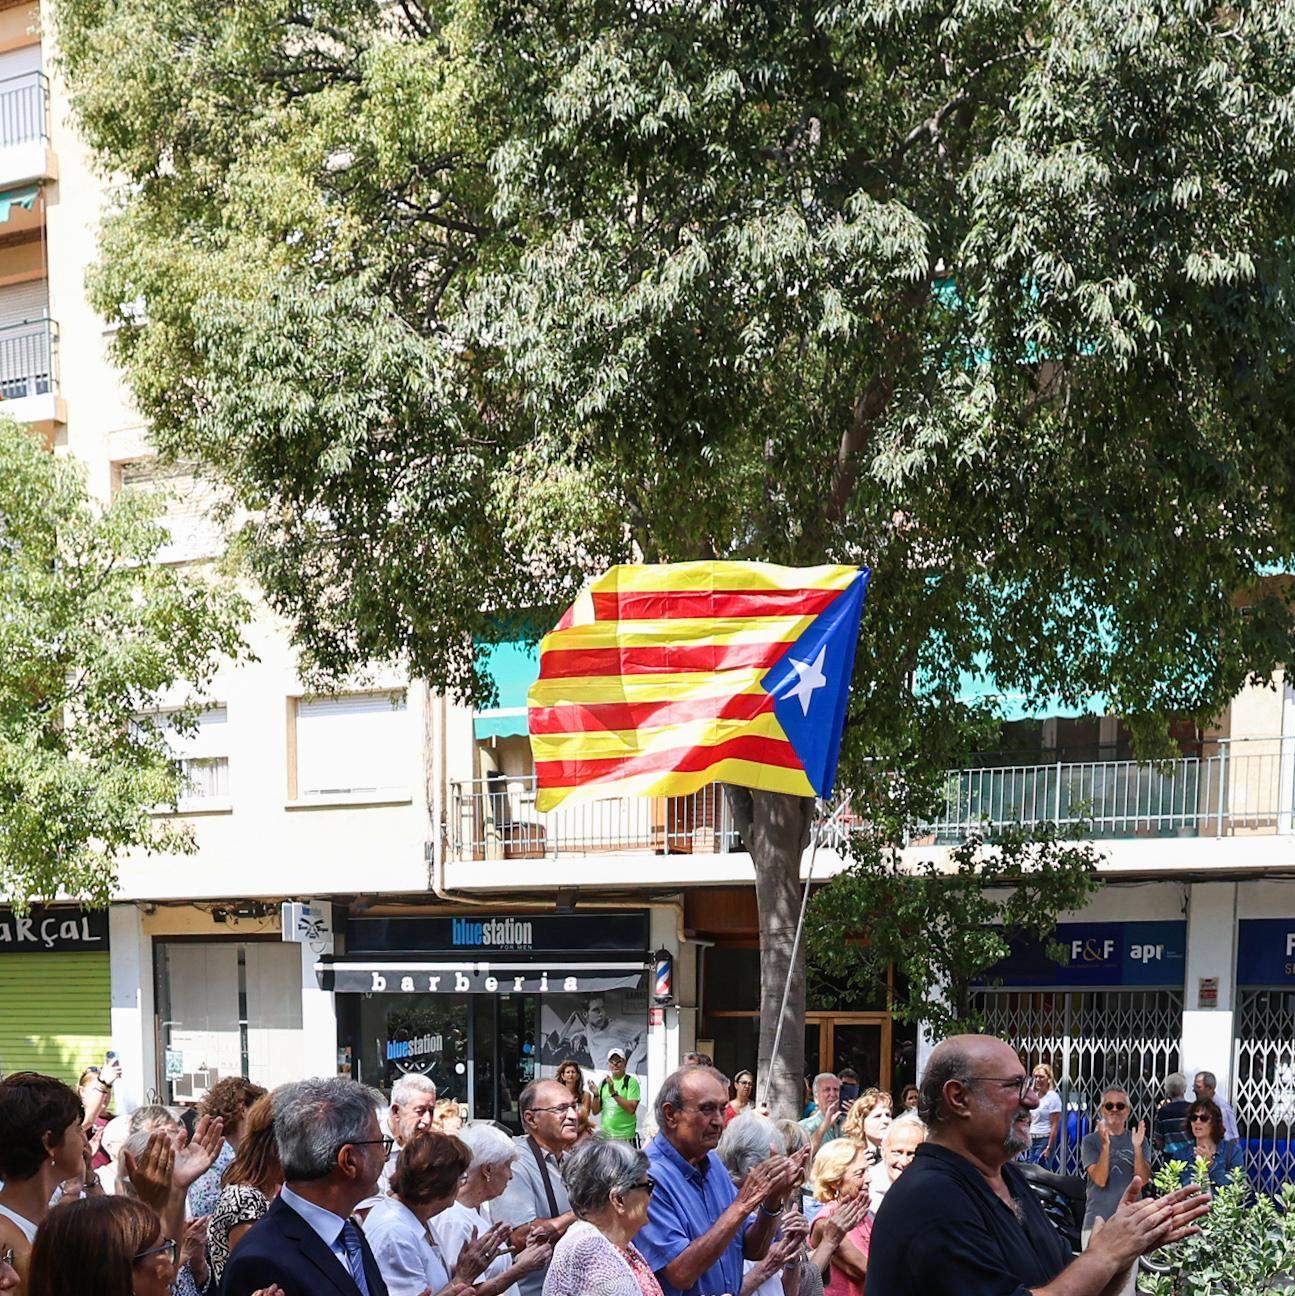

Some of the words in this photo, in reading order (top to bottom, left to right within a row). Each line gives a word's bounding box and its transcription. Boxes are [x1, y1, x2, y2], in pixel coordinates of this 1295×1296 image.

[452, 917, 532, 945] bluestation
[1071, 938, 1115, 961] F&F
[371, 972, 578, 992] barberia
[386, 1033, 443, 1060] bluestation
